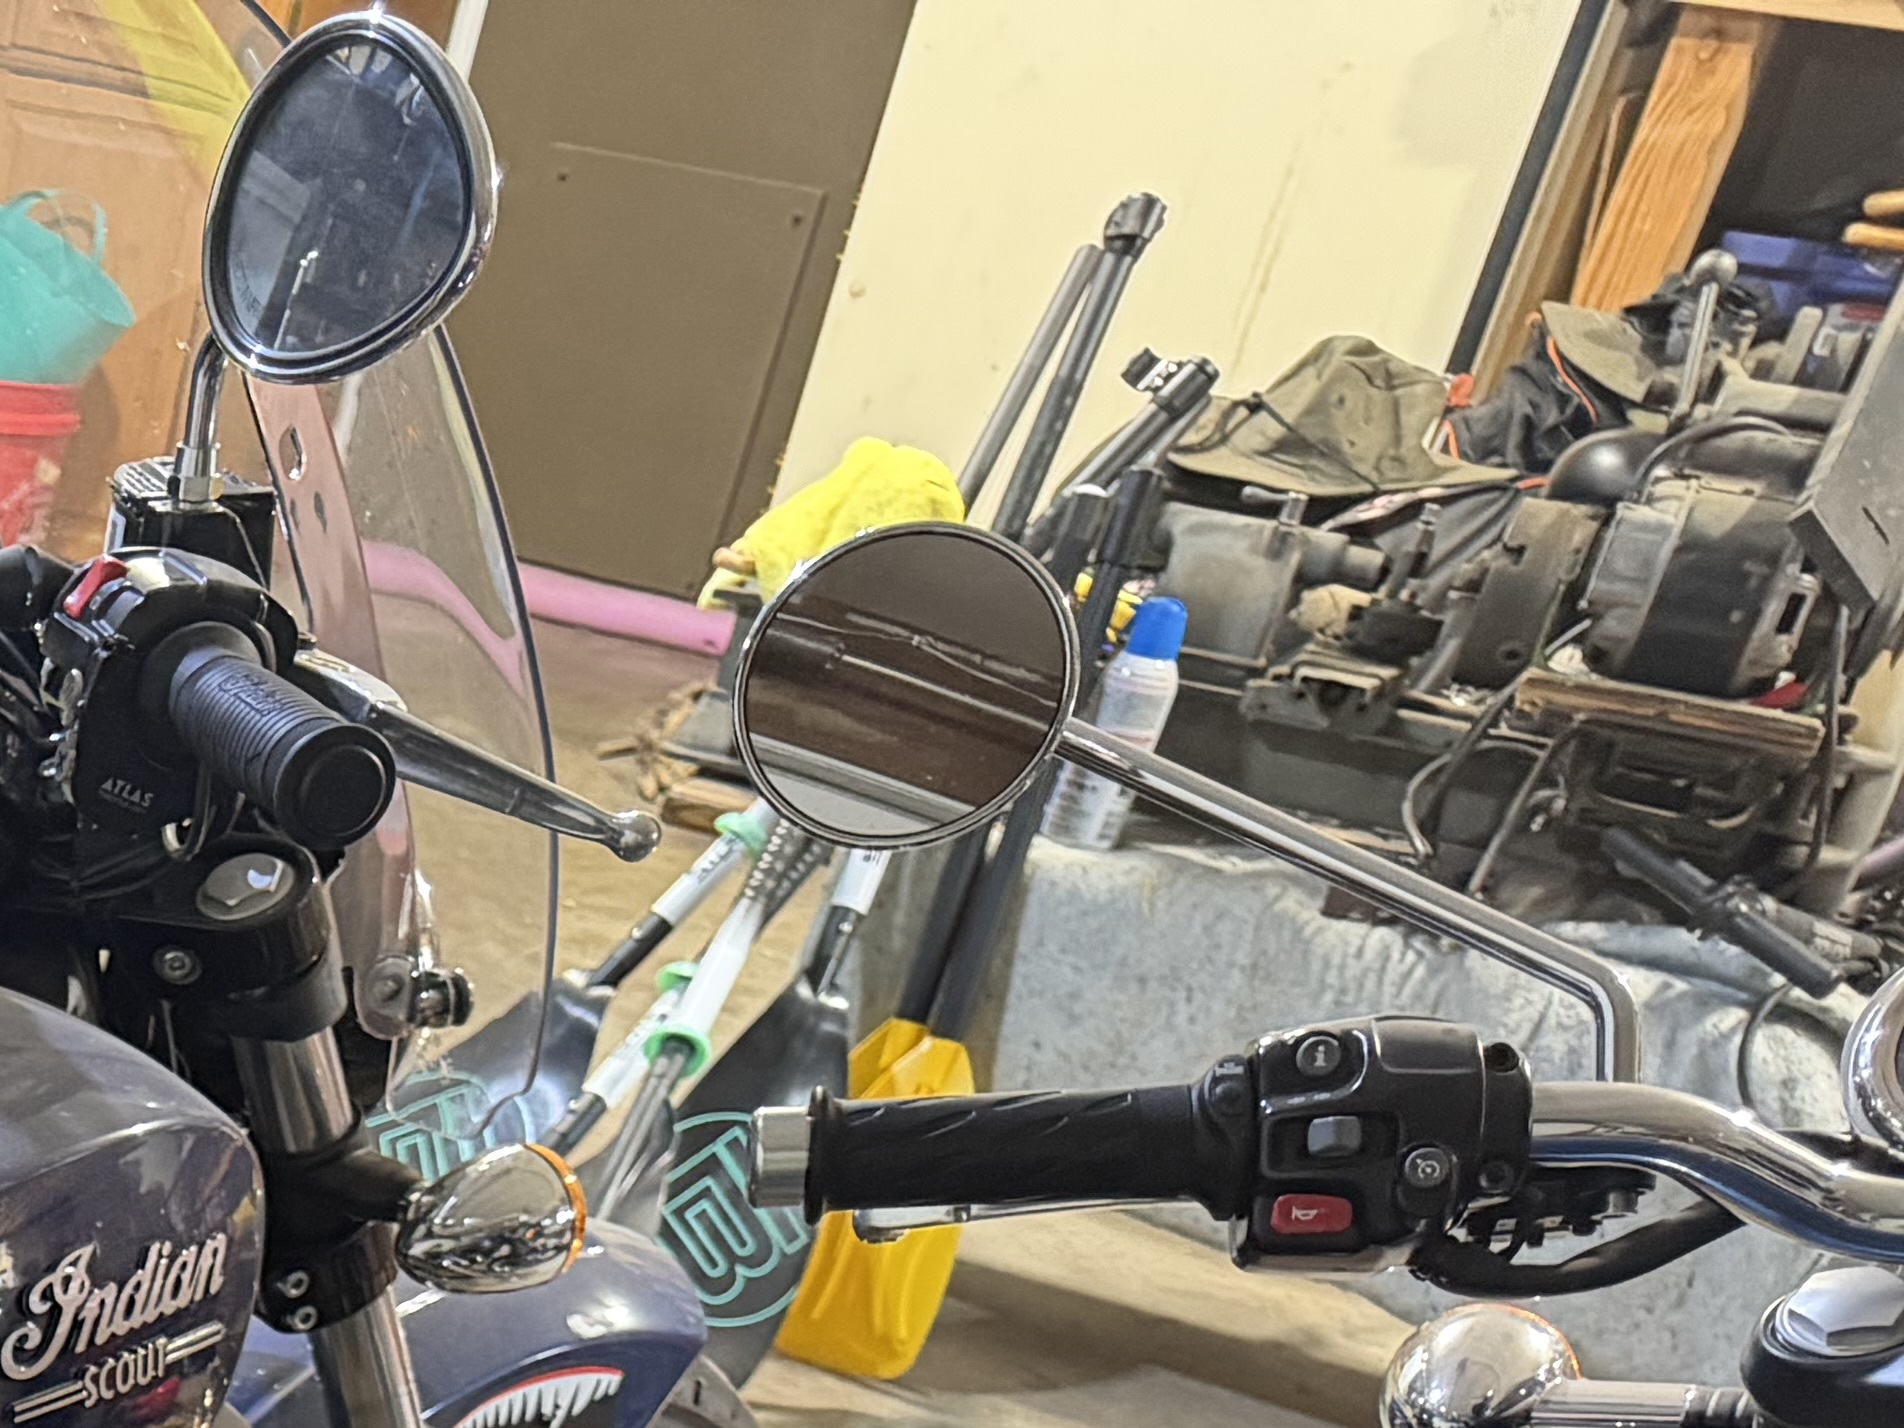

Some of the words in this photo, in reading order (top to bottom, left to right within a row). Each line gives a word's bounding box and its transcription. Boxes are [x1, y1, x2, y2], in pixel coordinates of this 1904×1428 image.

[100, 776, 154, 807] ATLAS
[0, 1232, 228, 1381] Indian
[83, 1336, 168, 1408] SCOUT
